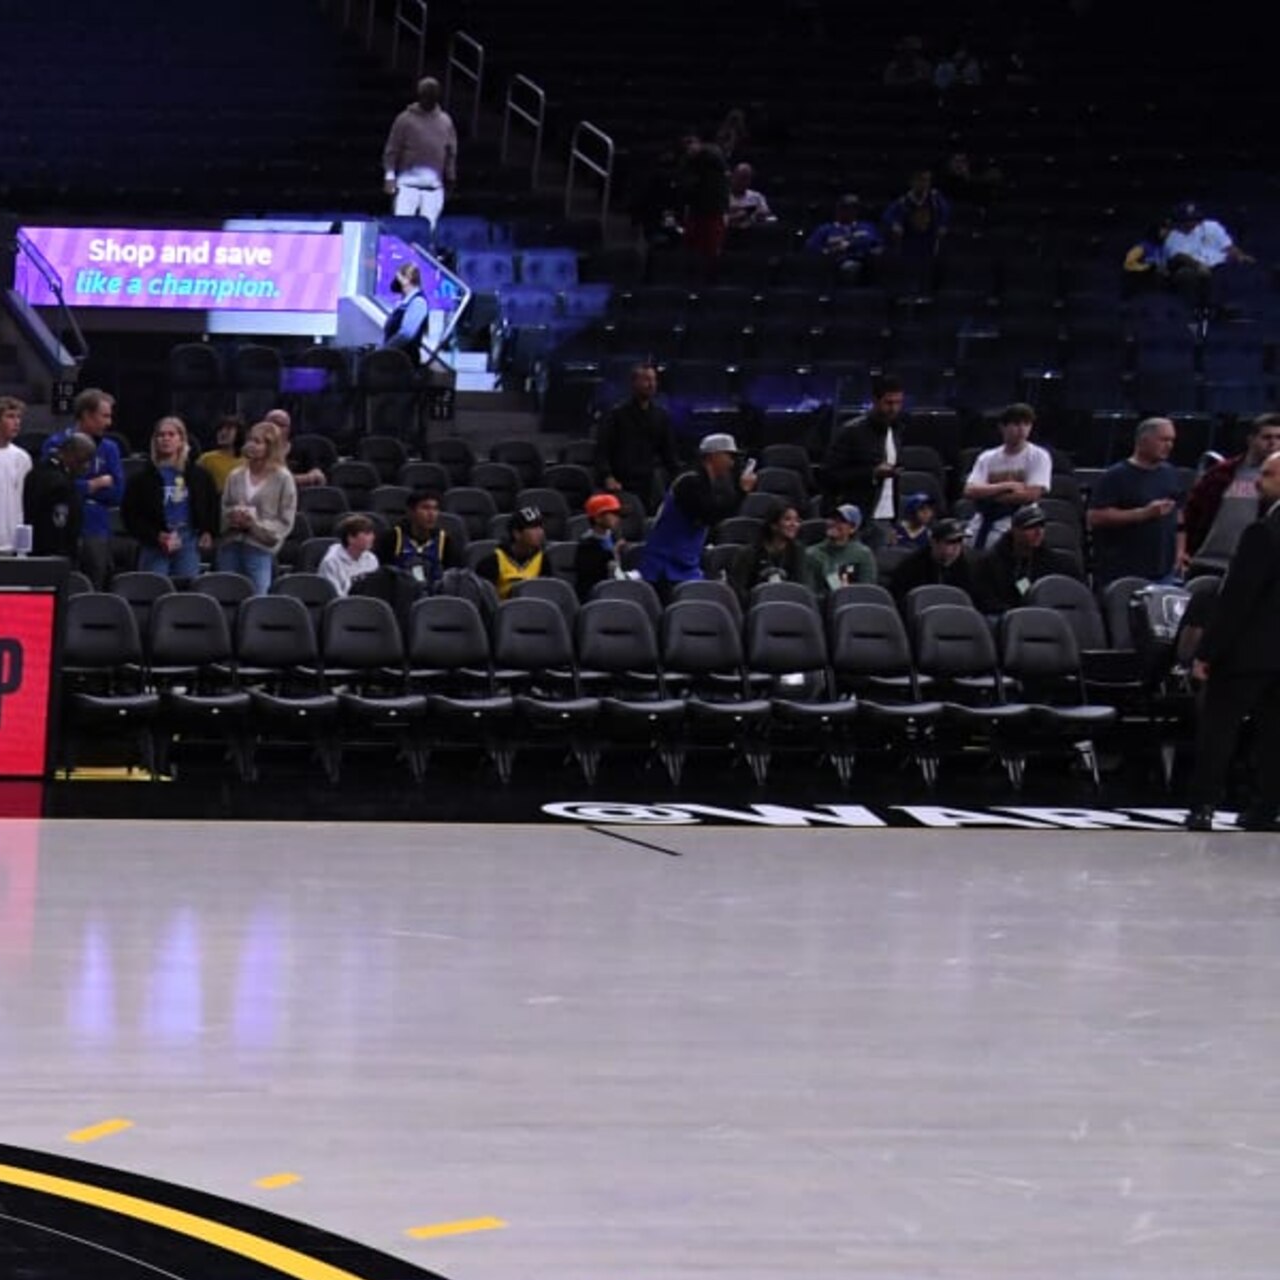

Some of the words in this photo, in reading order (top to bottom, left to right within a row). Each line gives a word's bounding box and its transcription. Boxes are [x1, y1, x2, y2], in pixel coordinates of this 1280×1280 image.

[90, 239, 156, 268] Shop
[160, 241, 210, 264] and
[214, 246, 272, 265] save
[76, 270, 122, 294] like
[127, 276, 142, 294] a
[147, 272, 280, 303] champion.
